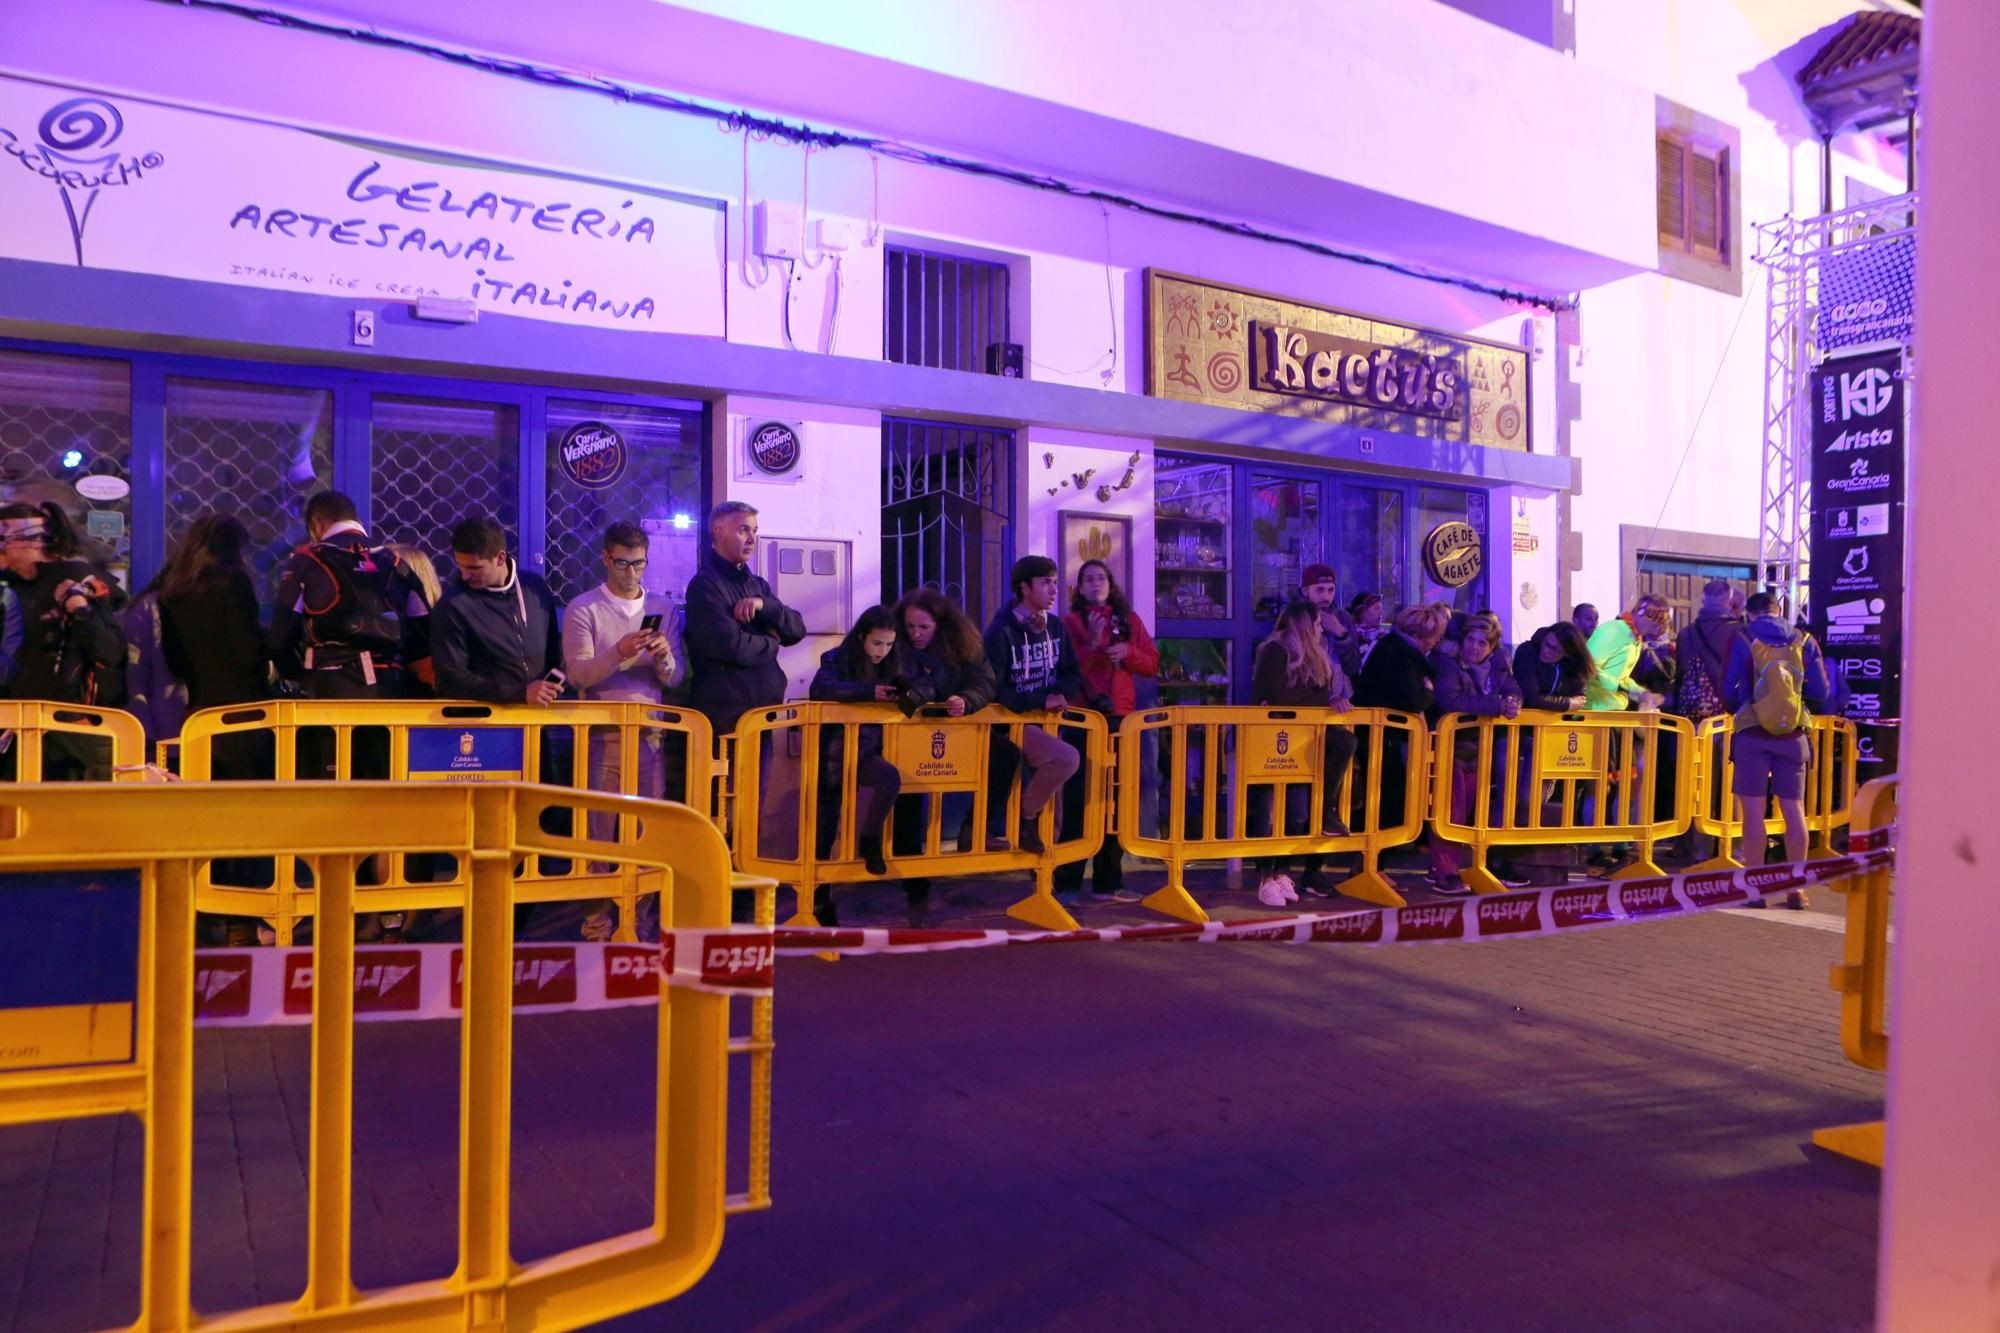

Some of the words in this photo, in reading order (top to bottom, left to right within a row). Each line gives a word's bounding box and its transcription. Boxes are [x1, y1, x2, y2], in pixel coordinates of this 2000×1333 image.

[229, 204, 515, 262] ARTESANAL
[356, 316, 372, 338] 6
[563, 434, 617, 463] VERGNANO
[753, 431, 792, 455] VERGNANO
[1824, 428, 1893, 454] Arista
[575, 448, 616, 480] 1882
[763, 442, 793, 468] 1882
[1436, 527, 1459, 556] CAFÉ
[1461, 529, 1473, 542] DE
[1443, 553, 1481, 579] AGAETE
[916, 769, 932, 777] Gran
[1623, 884, 1670, 905] Arista
[1685, 878, 1734, 896] Arista
[1479, 898, 1537, 921] Arista
[1553, 891, 1608, 914] Arista
[1400, 906, 1458, 928] Arista
